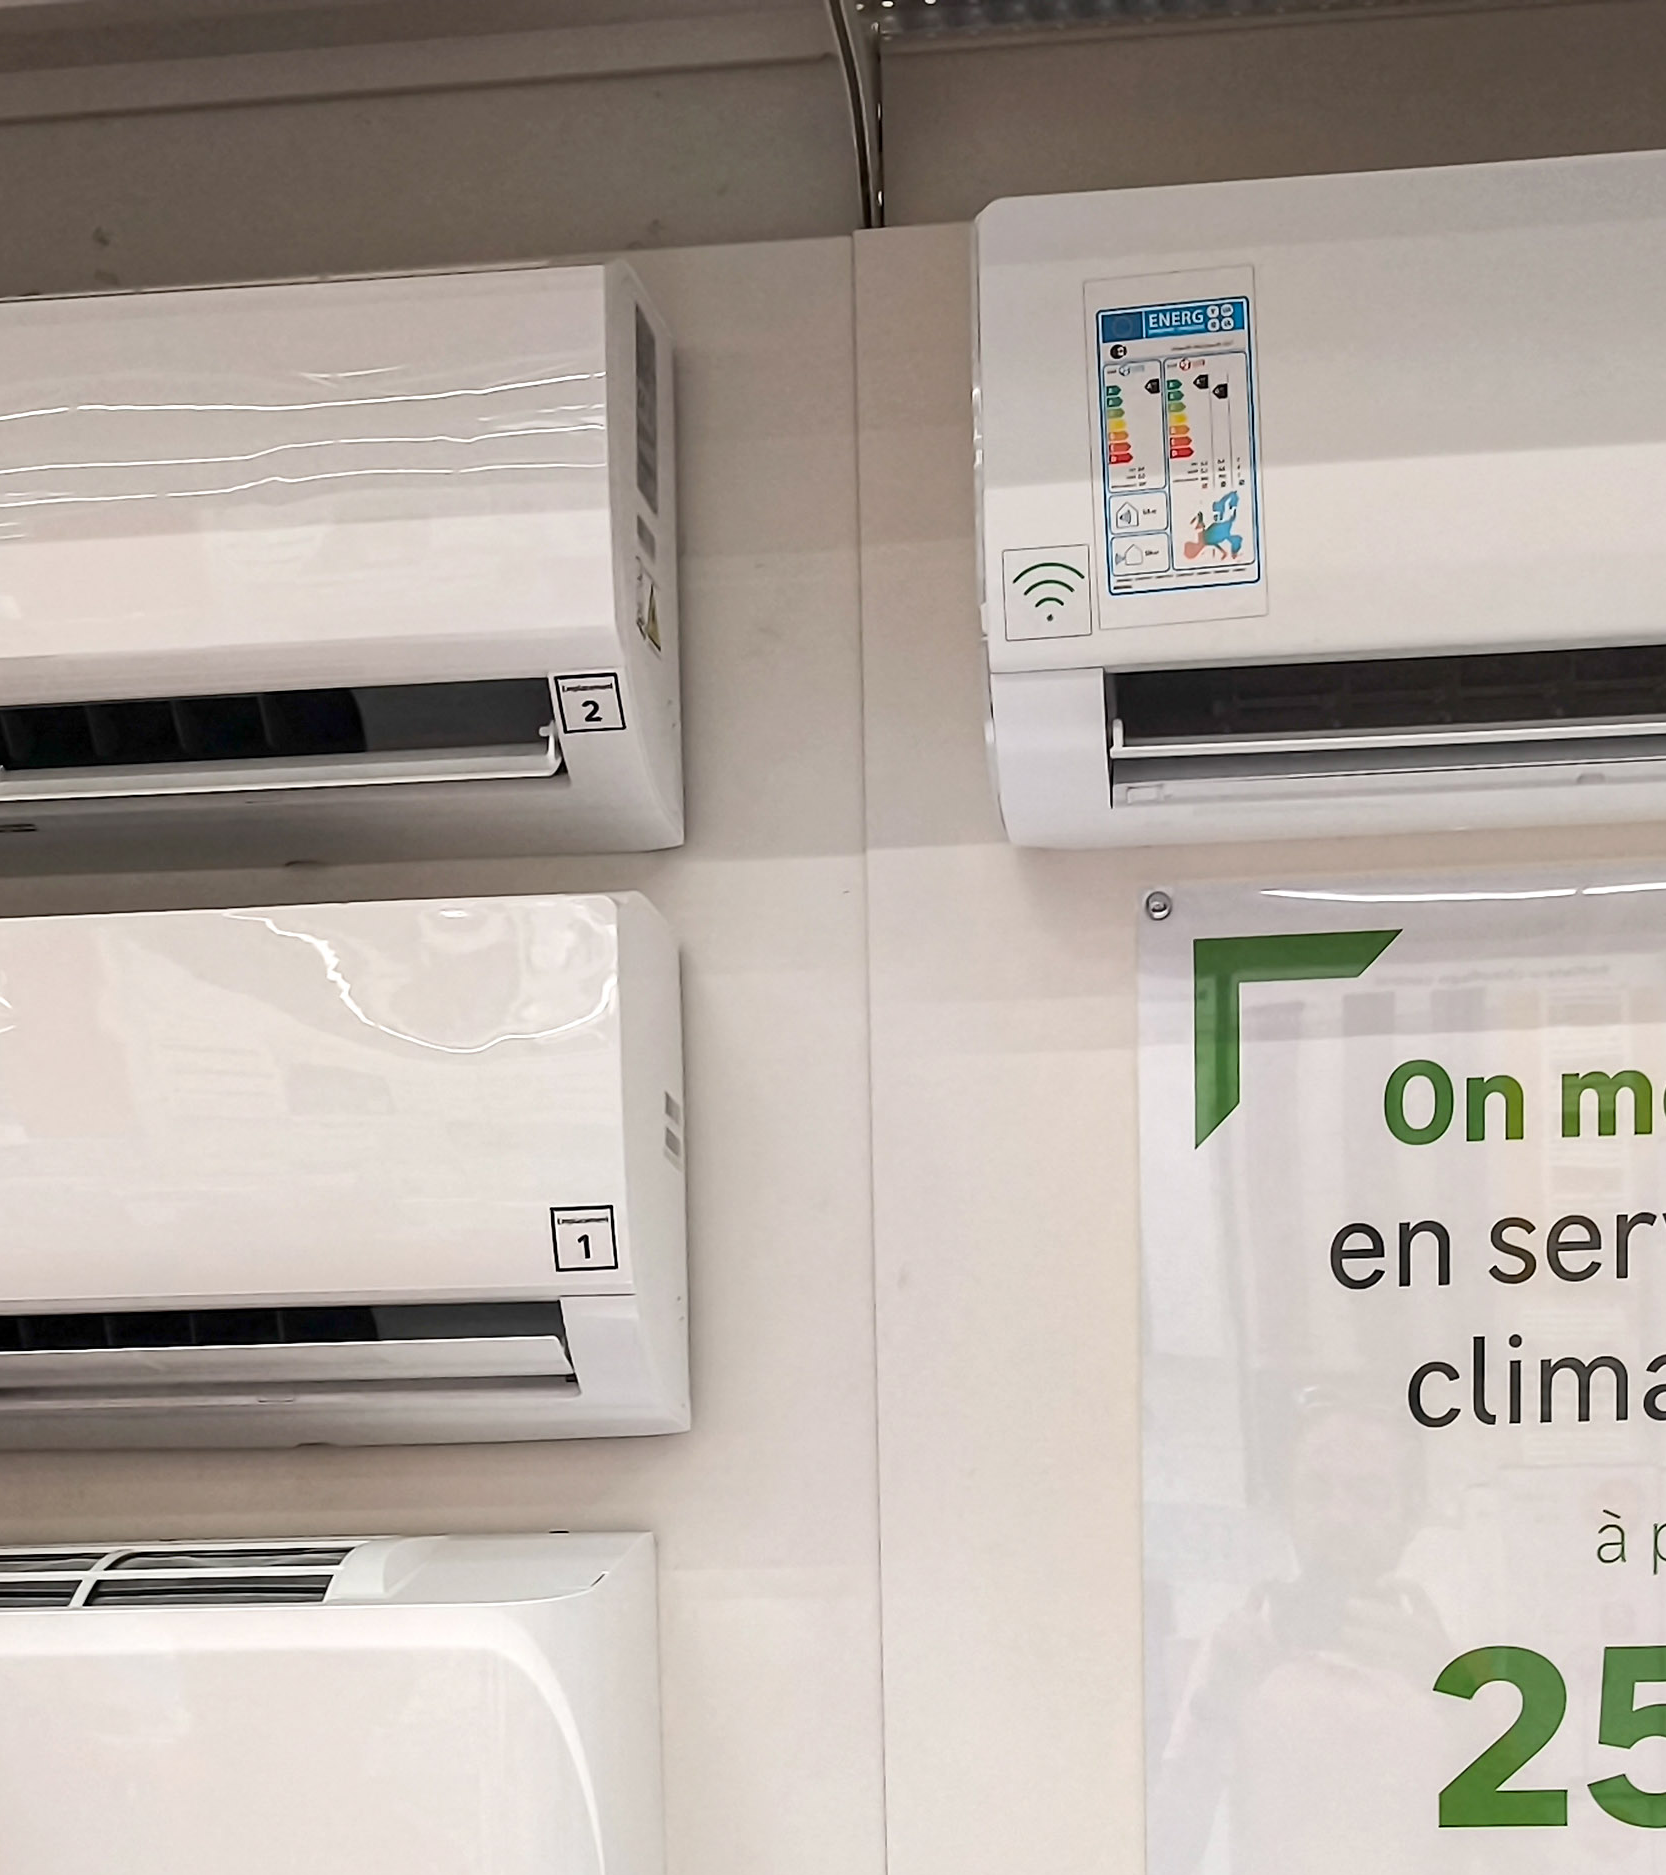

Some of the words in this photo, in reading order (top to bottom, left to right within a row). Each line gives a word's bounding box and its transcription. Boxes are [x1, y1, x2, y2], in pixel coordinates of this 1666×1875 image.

[1148, 310, 1204, 328] ENERG
[582, 700, 603, 722] 2
[1384, 1060, 1524, 1145] On
[578, 1234, 590, 1259] 1
[1332, 1217, 1452, 1289] en
[1596, 1508, 1627, 1564] à
